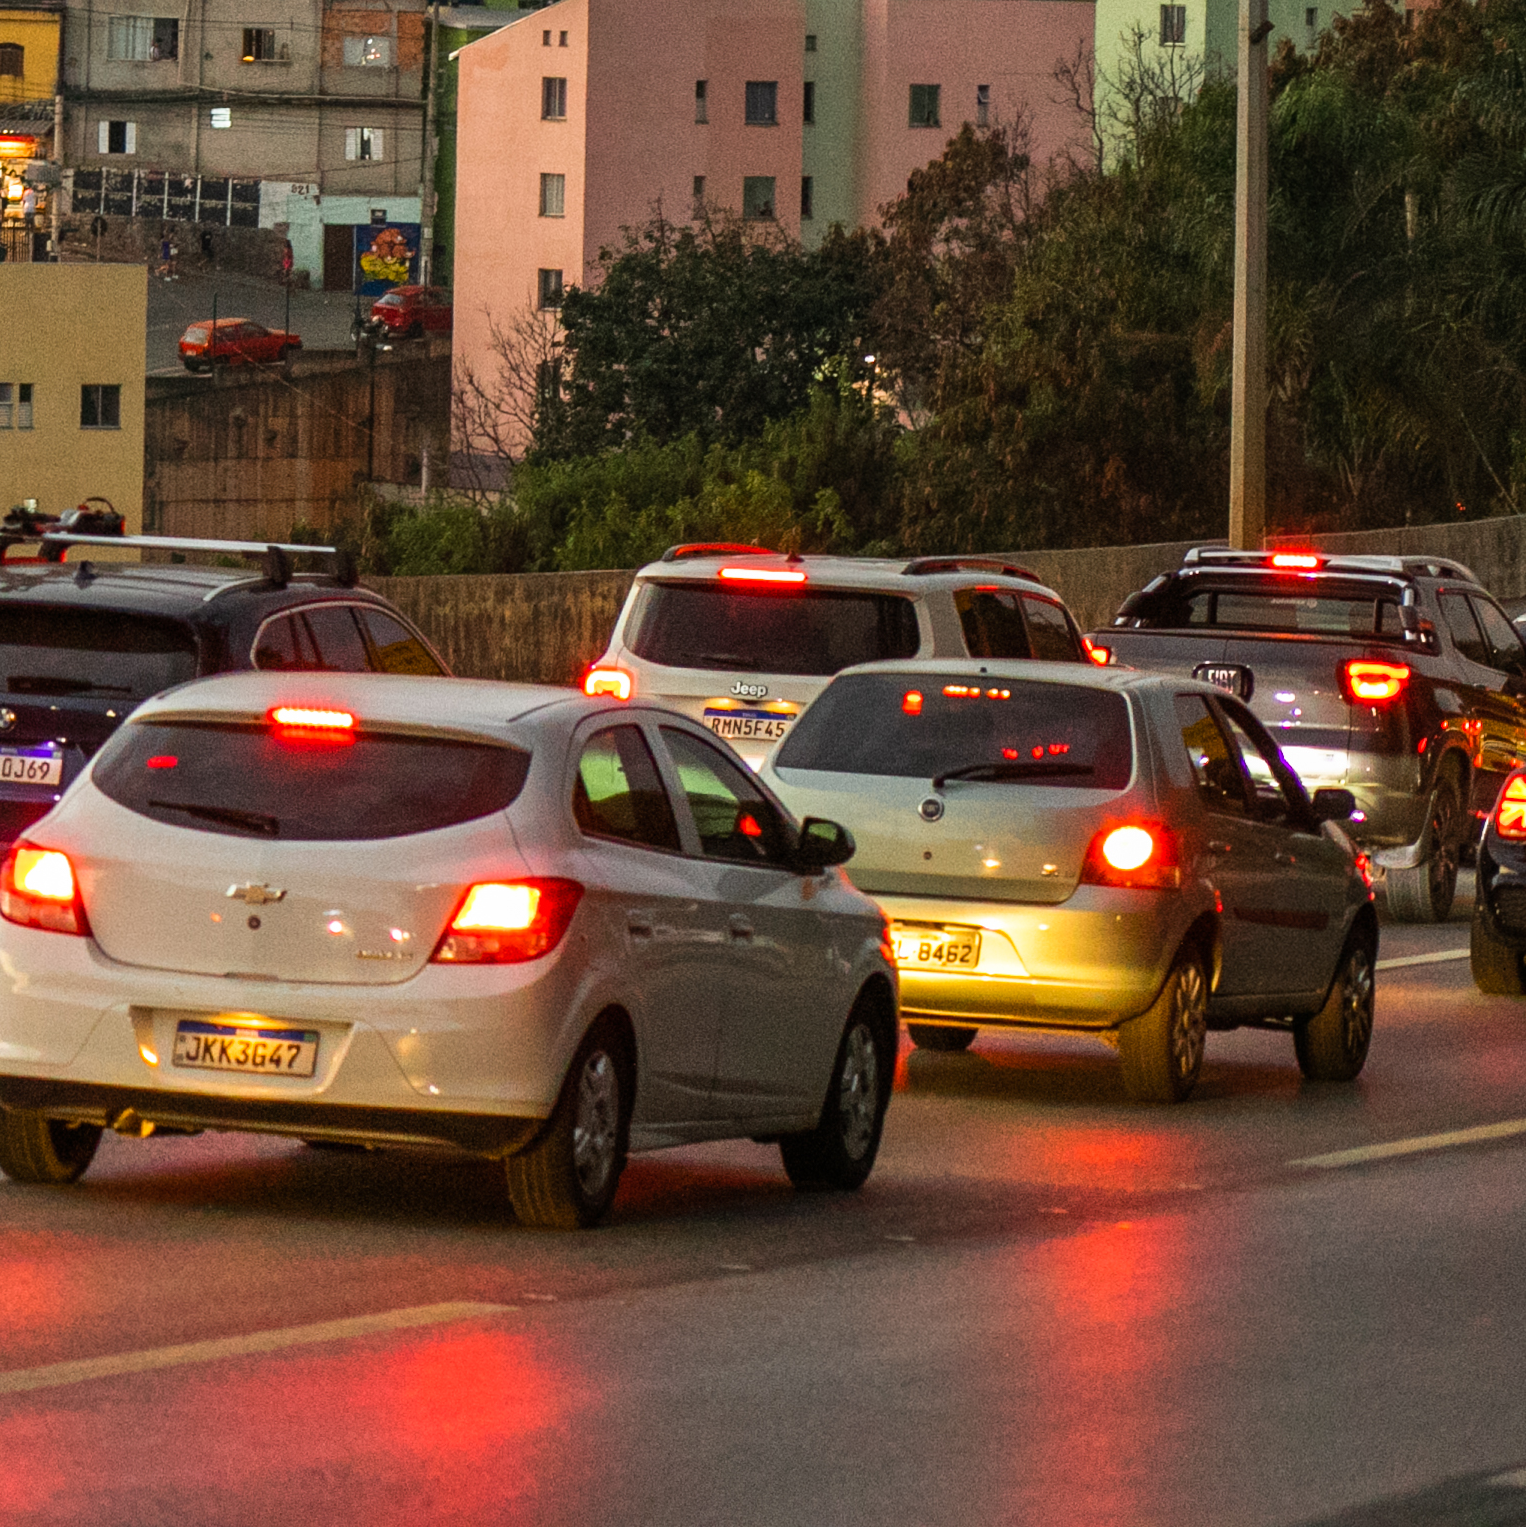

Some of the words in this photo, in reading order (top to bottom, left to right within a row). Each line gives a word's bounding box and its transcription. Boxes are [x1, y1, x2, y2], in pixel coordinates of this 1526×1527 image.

[730, 681, 768, 698] Jeep
[711, 717, 786, 738] RMN5F45
[185, 1035, 302, 1070] JKK3G47
